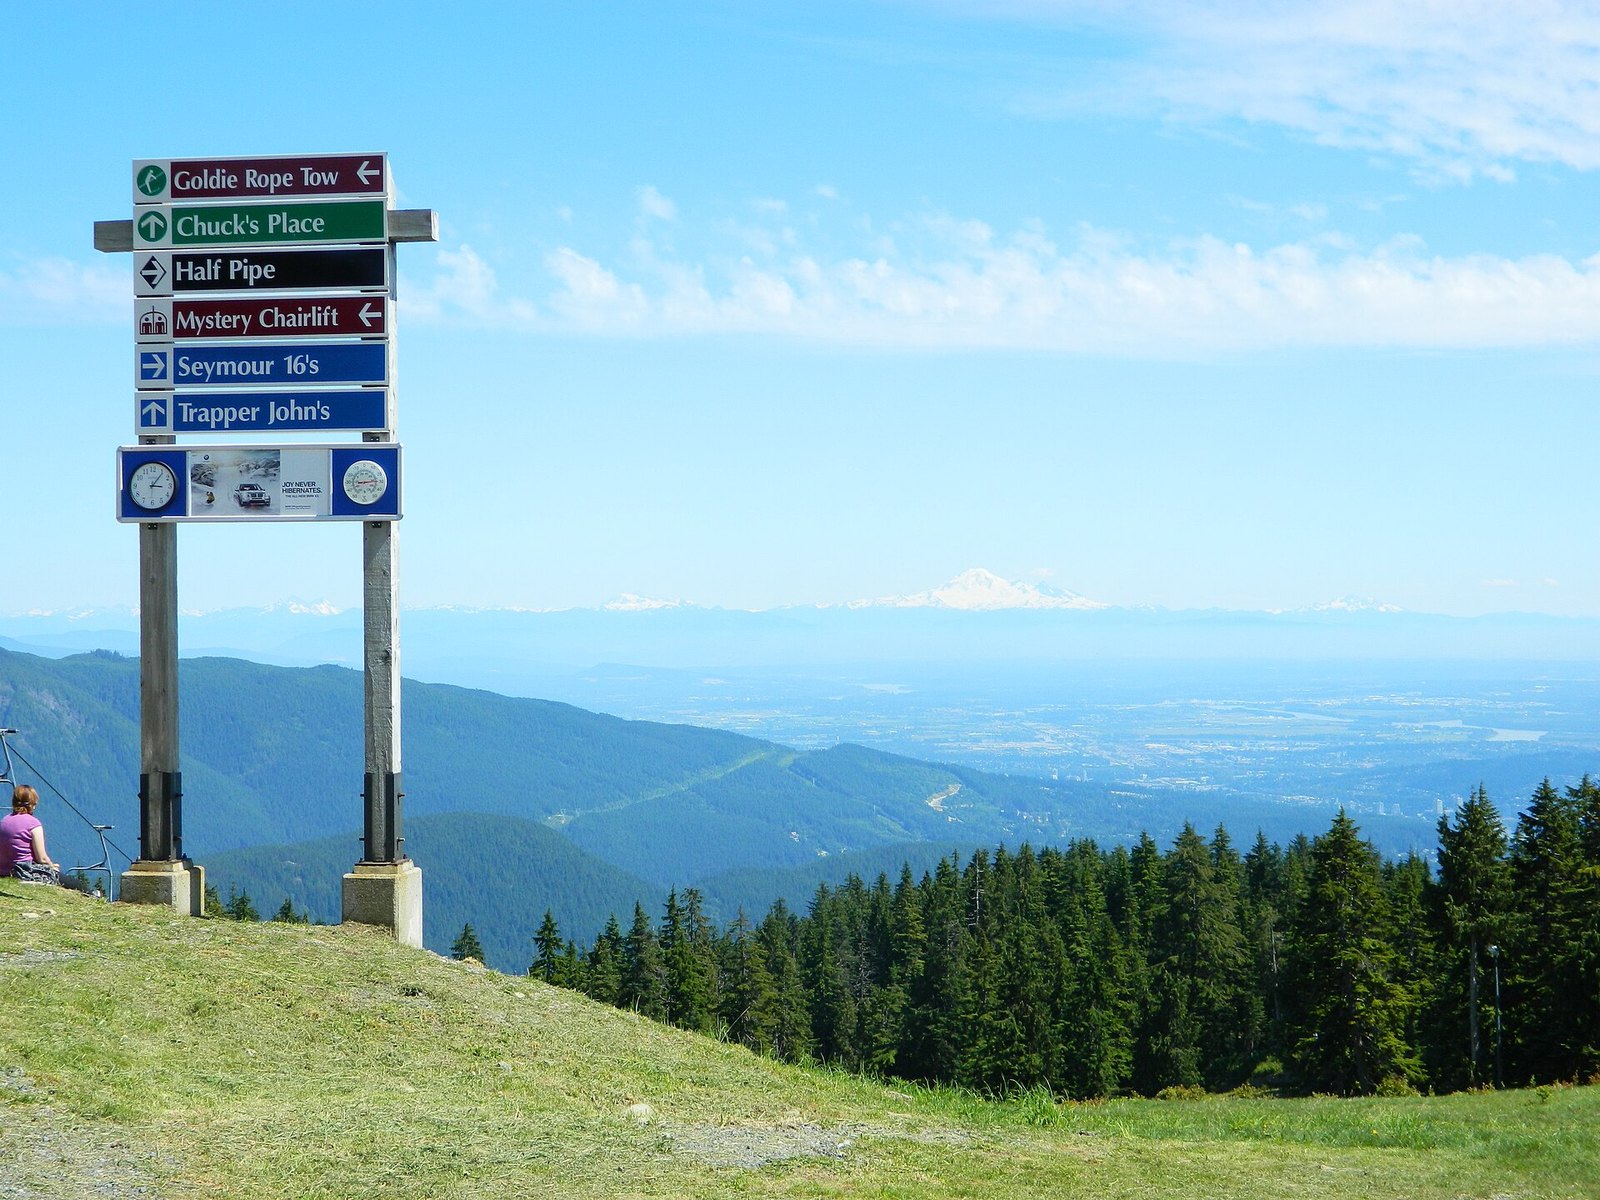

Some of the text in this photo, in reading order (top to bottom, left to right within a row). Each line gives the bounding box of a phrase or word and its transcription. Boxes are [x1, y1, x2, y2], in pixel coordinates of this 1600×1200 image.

[174, 166, 339, 193] Goldie Rope Tow
[176, 212, 325, 236] Chuck's Place
[176, 258, 276, 286] Half Pipe
[176, 305, 339, 335] Mystery Chairlift
[178, 354, 320, 382] Seymour 16's
[178, 400, 331, 429] Trapper John's
